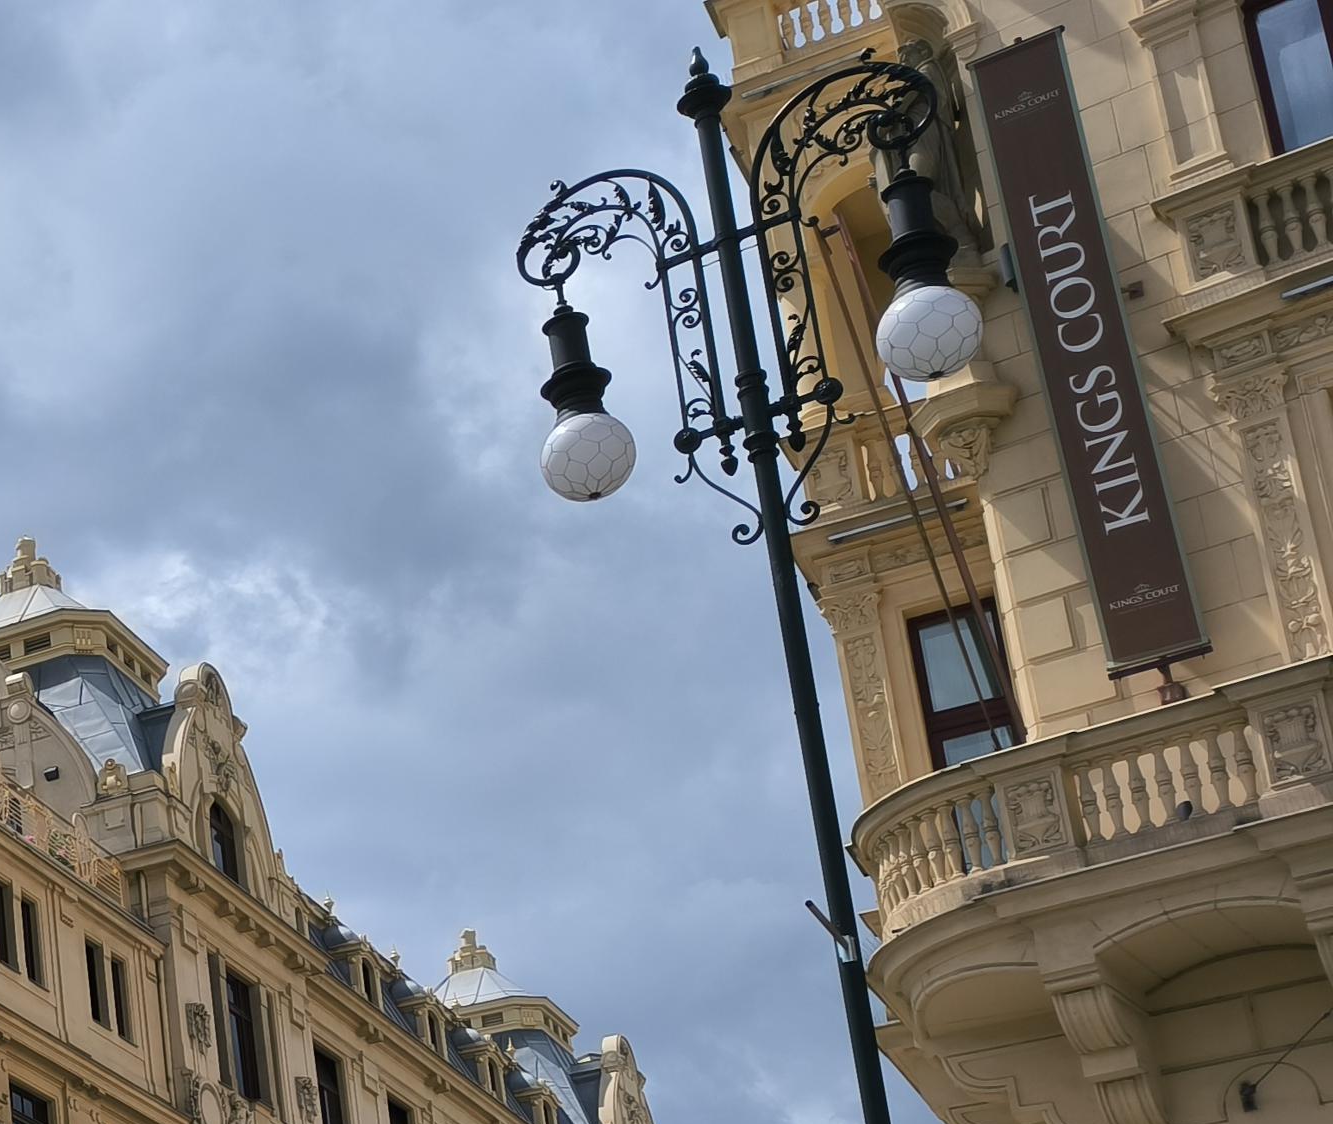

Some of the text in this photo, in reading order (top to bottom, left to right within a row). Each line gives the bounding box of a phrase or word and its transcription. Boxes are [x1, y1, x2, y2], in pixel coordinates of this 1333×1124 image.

[994, 103, 1026, 120] KINGS
[1028, 88, 1061, 106] COURT
[1028, 189, 1104, 353] COURT
[1069, 364, 1151, 535] KINGS
[1109, 596, 1143, 610] KINGS
[1145, 584, 1180, 600] COURT
